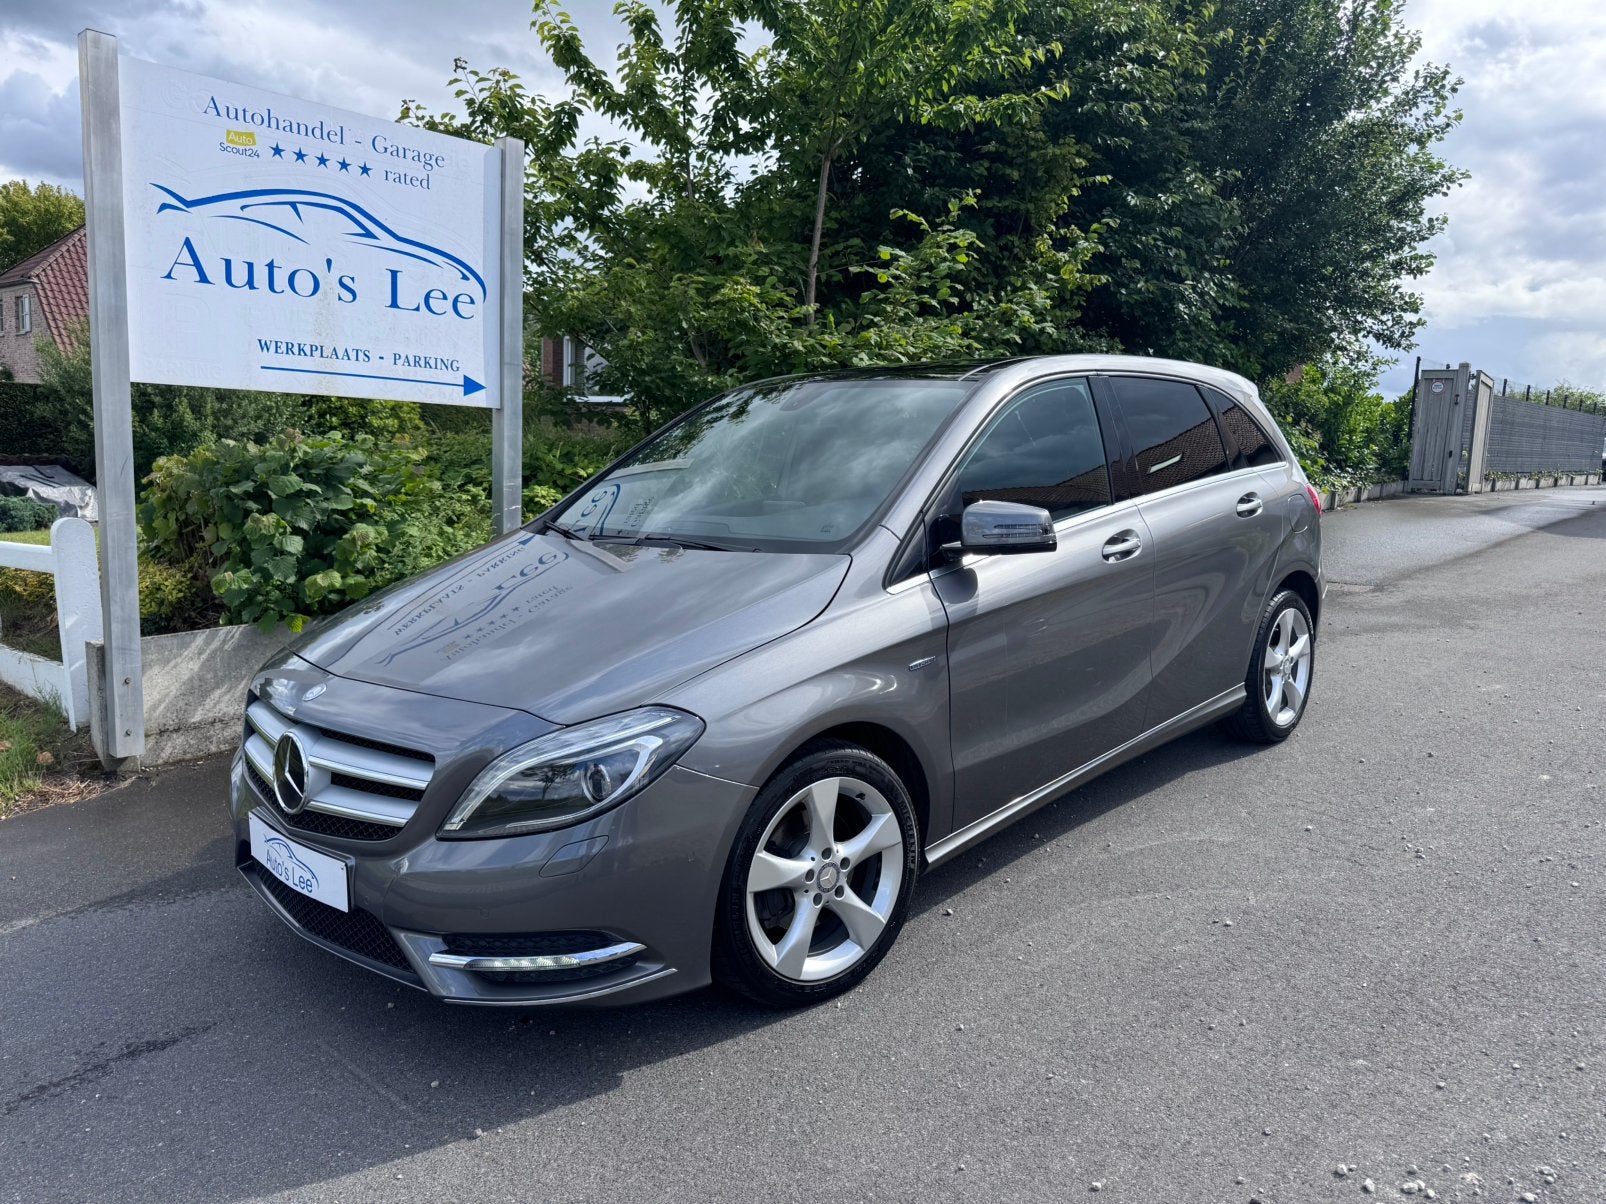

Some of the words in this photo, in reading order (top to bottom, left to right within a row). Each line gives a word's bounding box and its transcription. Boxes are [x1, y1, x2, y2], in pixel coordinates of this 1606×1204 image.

[203, 95, 345, 145] Autohandel
[371, 134, 445, 171] Garage
[219, 142, 260, 158] Scout24
[228, 131, 253, 145] Auto
[383, 168, 431, 190] rated
[160, 236, 357, 303] Auto's
[384, 268, 476, 320] Lee
[257, 338, 371, 363] WERKPLAATS
[392, 352, 460, 372] PARKING
[266, 848, 290, 882] Auto's
[292, 866, 313, 894] Lee
